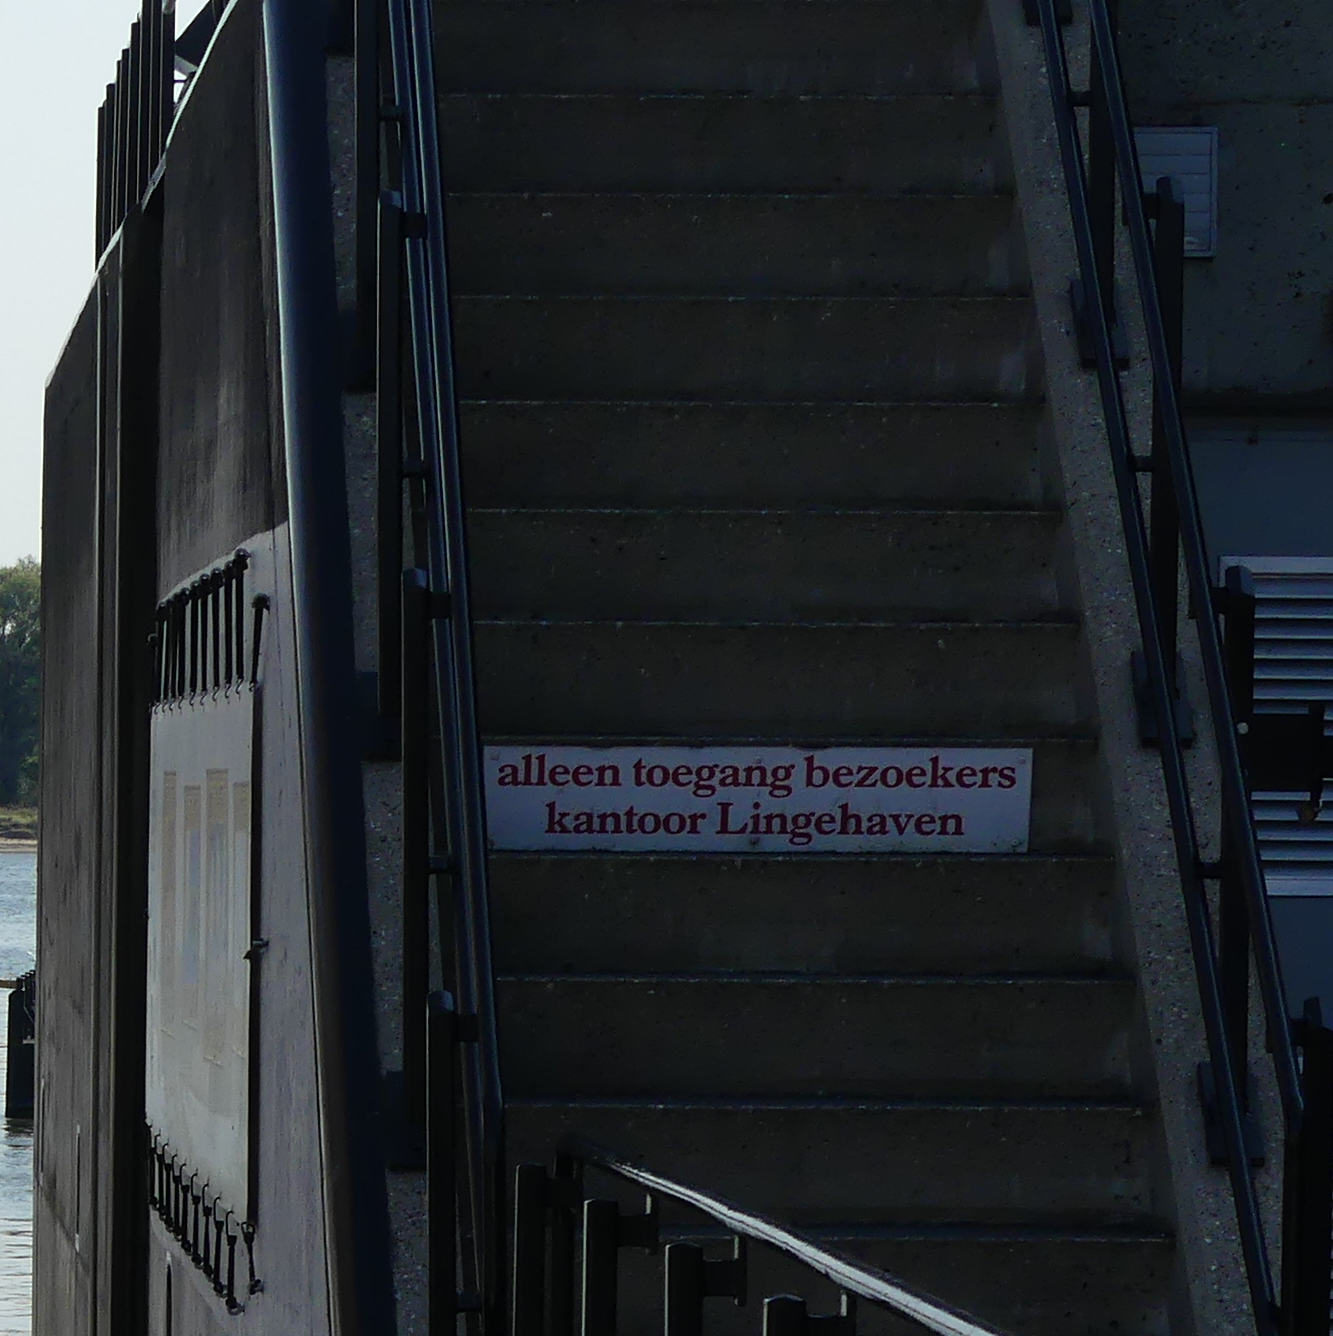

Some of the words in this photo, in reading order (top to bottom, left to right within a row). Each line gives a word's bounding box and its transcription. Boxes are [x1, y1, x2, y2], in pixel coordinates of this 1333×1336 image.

[498, 753, 622, 787] alleen
[633, 757, 795, 798] toegang
[804, 755, 1017, 789] bezoekers
[544, 800, 707, 835] kantoor
[715, 801, 965, 846] Lingehaven
